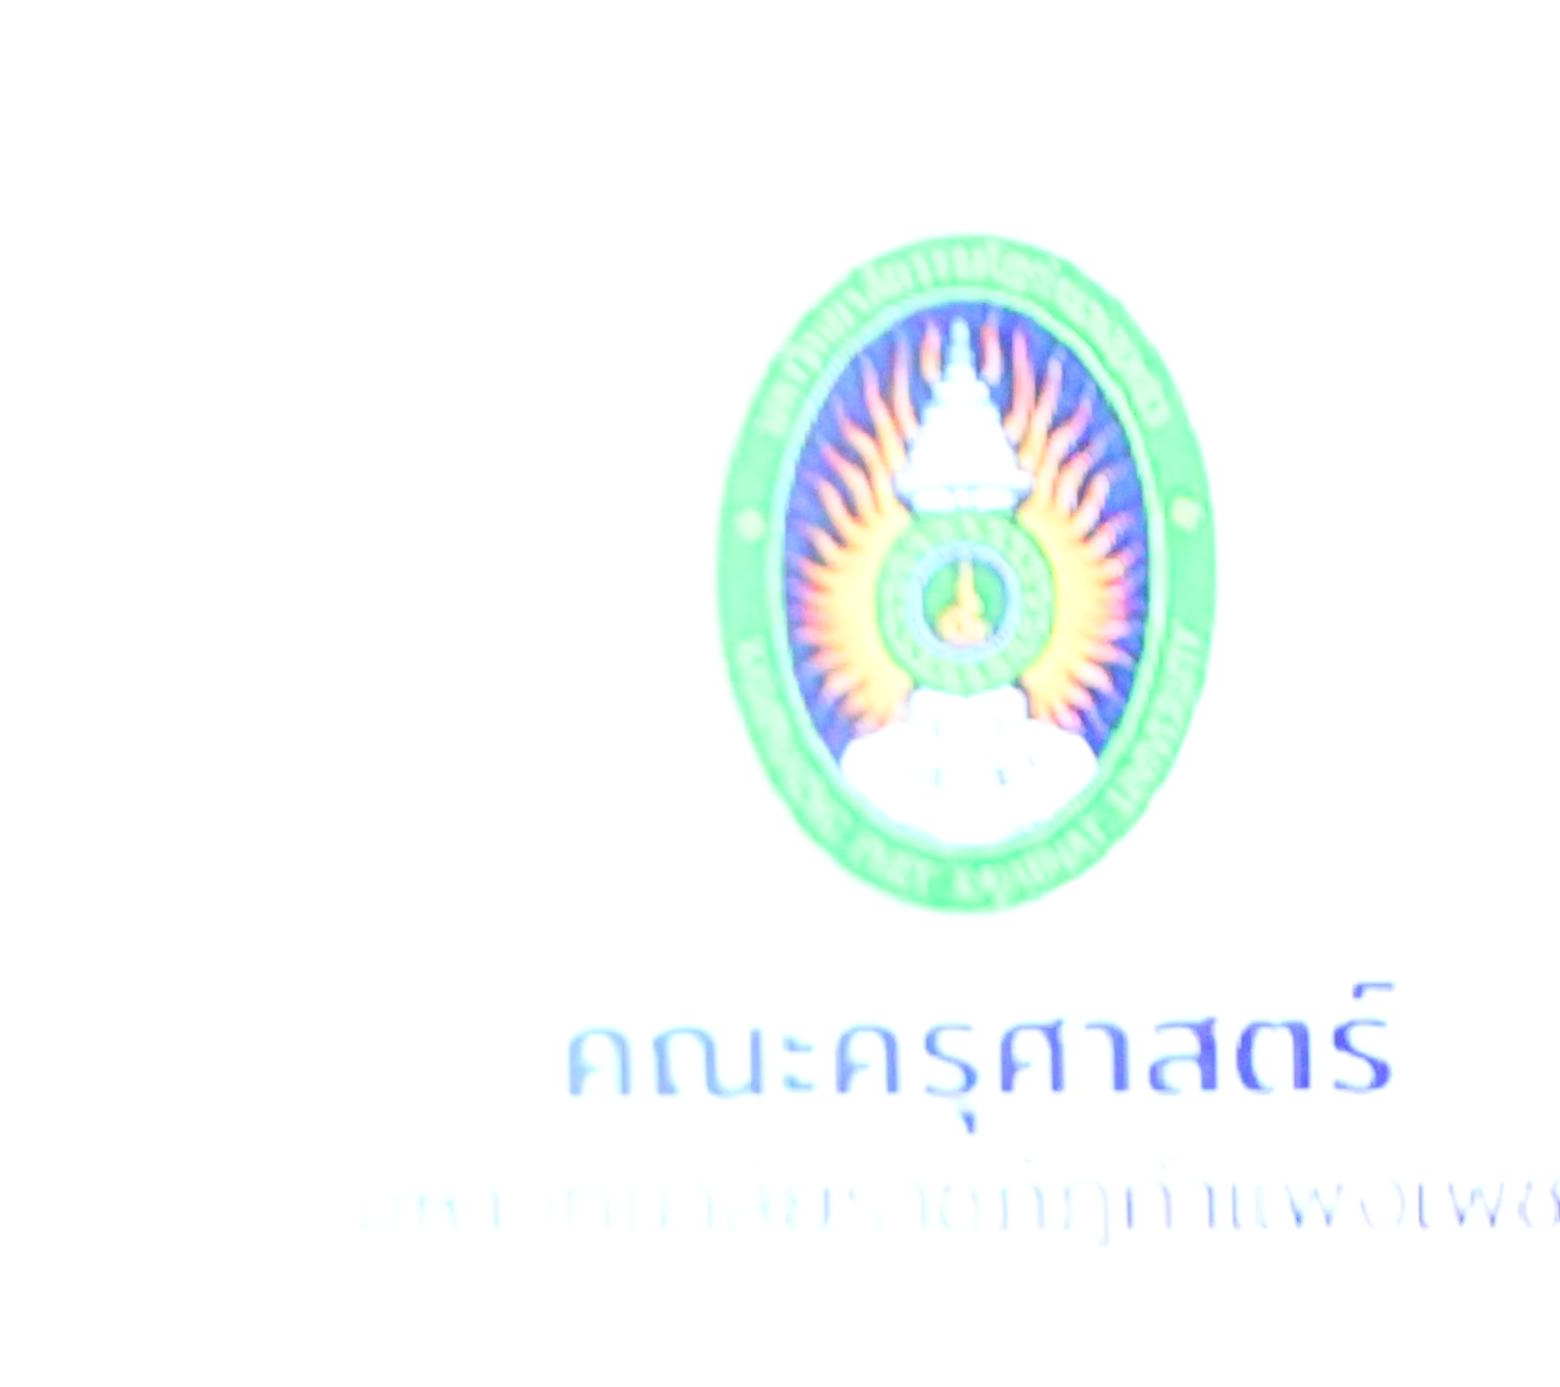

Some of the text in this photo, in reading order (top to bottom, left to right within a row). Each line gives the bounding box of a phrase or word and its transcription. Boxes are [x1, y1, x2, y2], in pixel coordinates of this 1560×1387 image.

[567, 979, 1396, 1137] คณะครุศาสตร์
